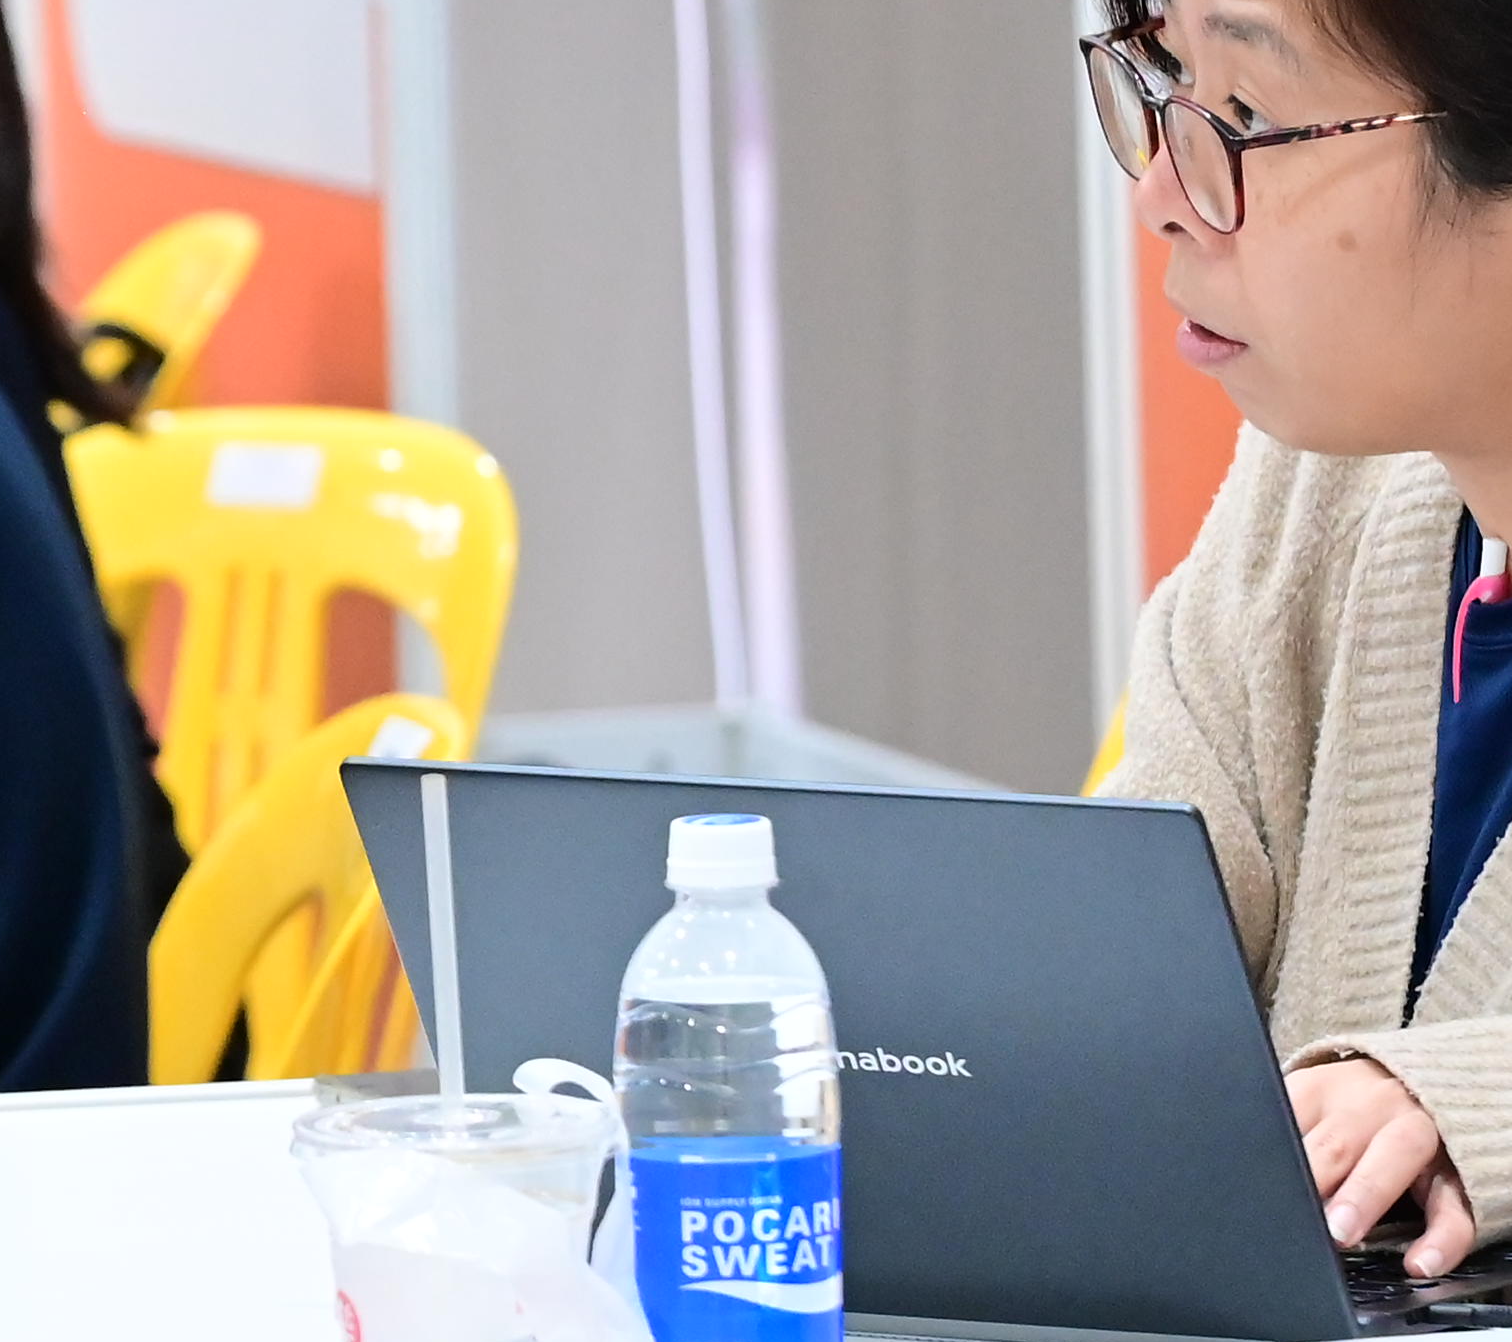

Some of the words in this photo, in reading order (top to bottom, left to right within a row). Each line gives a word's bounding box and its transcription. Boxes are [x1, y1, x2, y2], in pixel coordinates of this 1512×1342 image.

[837, 1046, 974, 1077] nabook
[681, 1197, 840, 1244] POCARI
[681, 1234, 834, 1278] SWEAT
